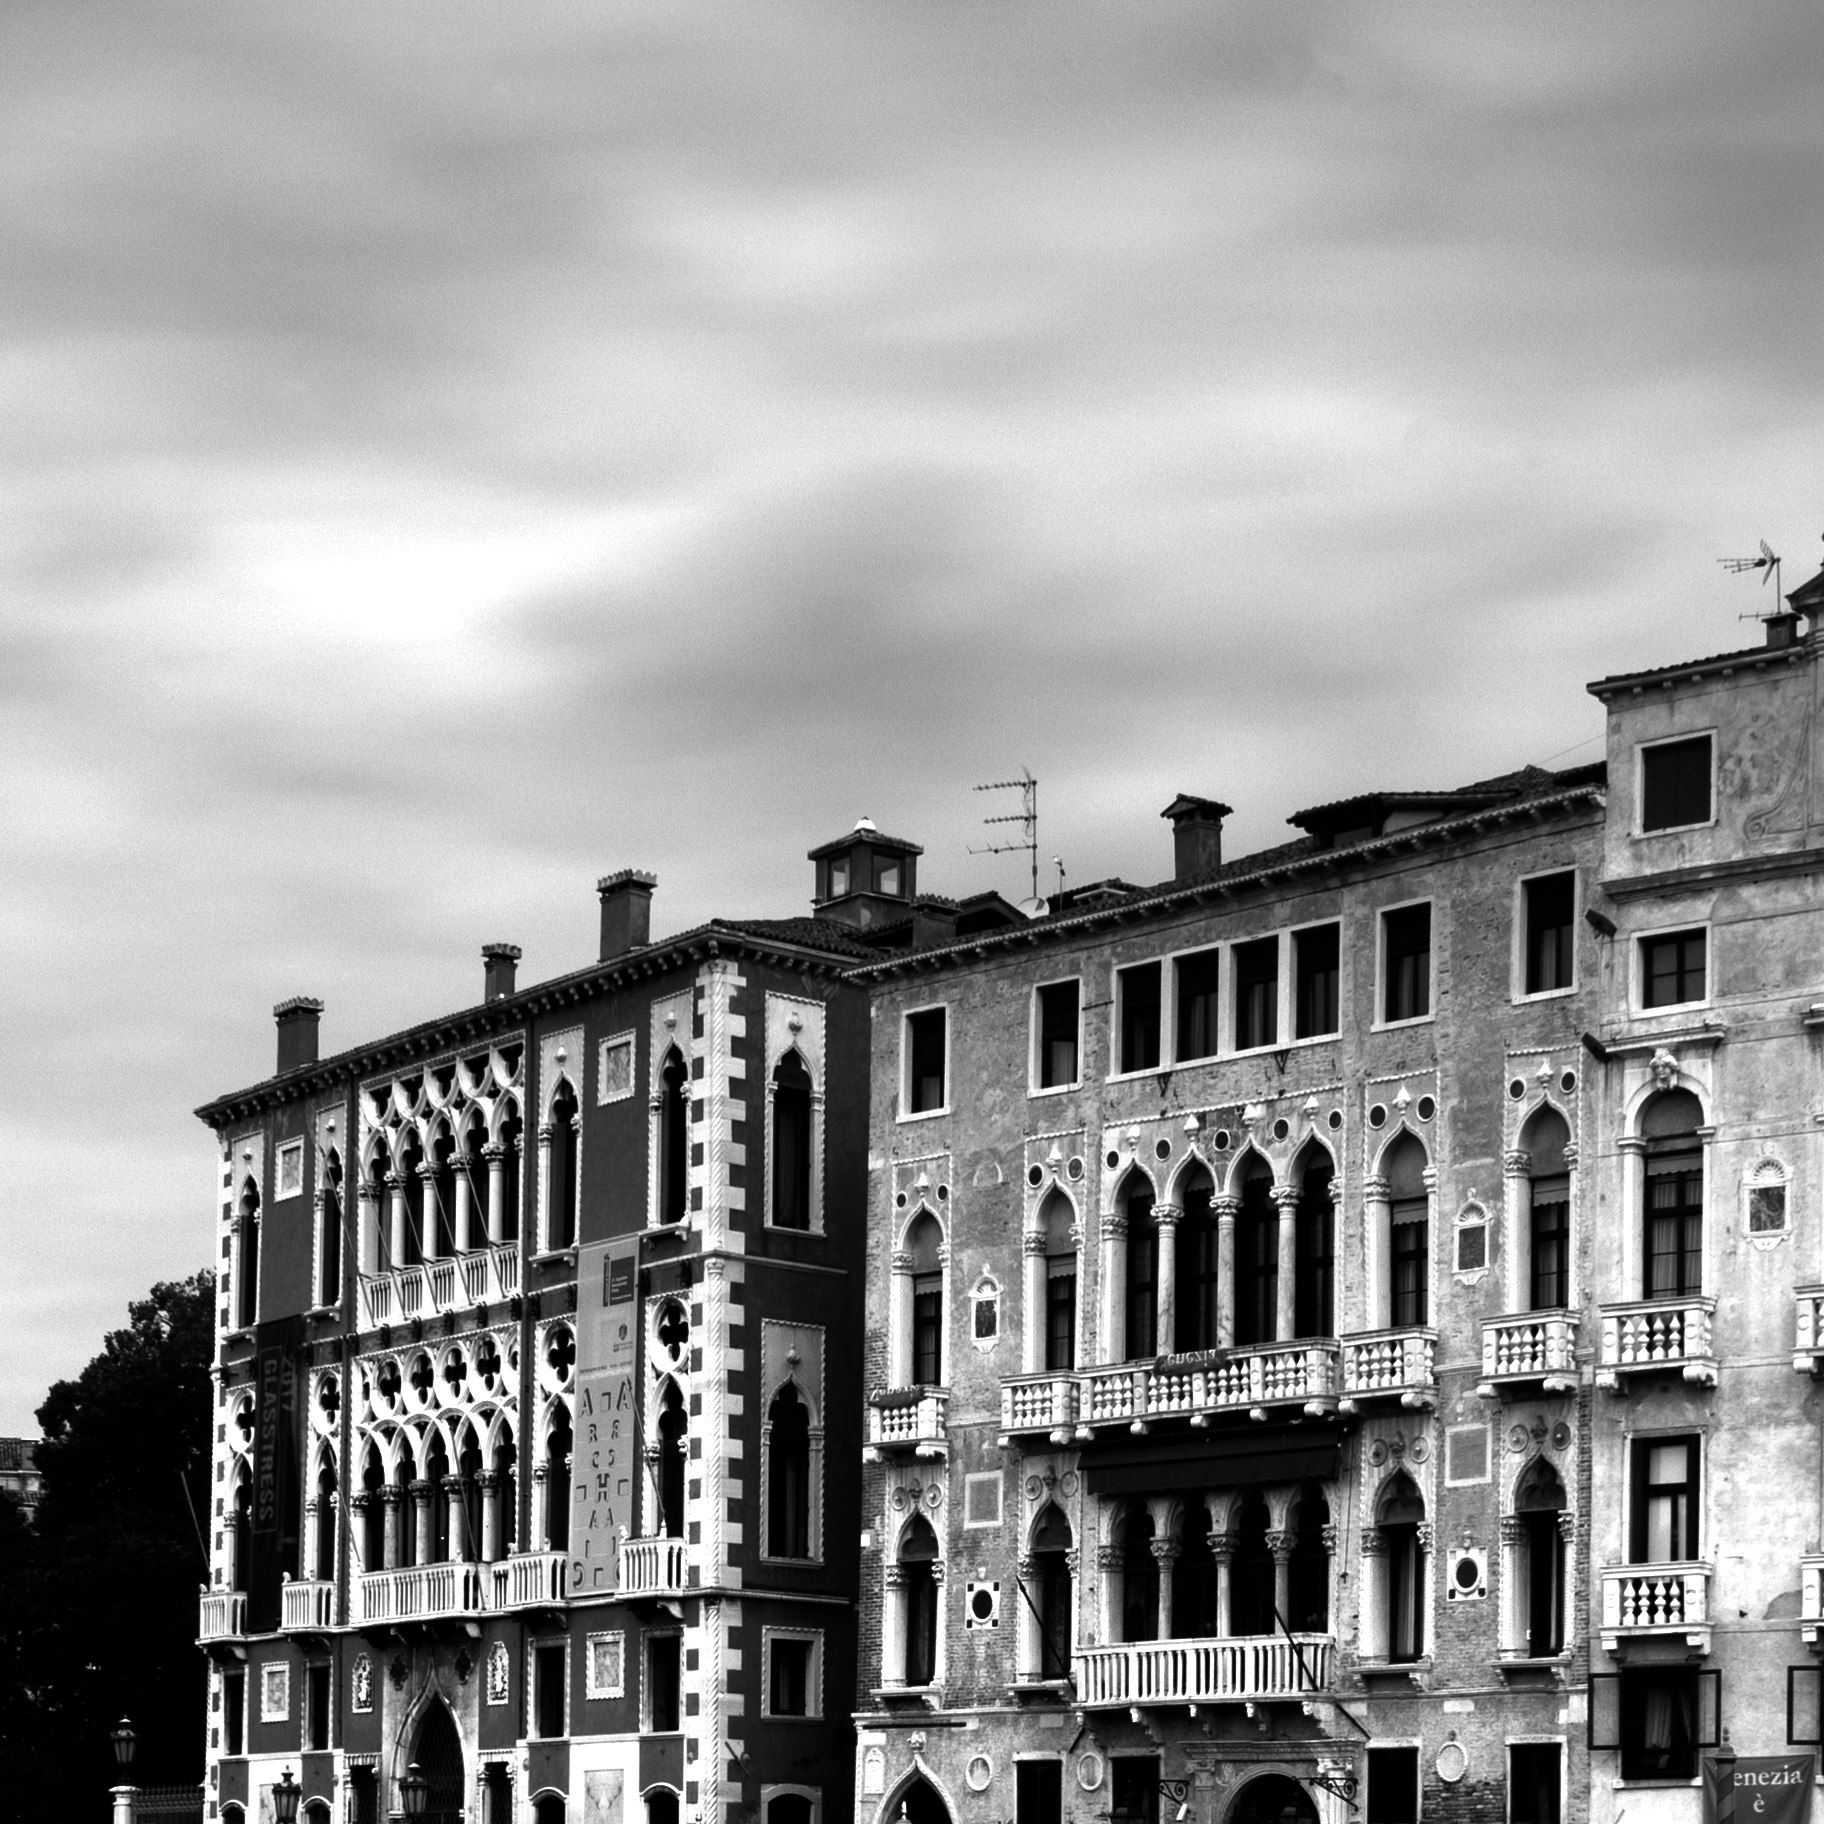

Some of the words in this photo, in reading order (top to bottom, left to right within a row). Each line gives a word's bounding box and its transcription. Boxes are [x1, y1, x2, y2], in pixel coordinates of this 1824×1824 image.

[259, 1358, 278, 1521] GLASSTRESS
[1733, 1764, 1803, 1787] enezia
[1753, 1793, 1765, 1814] è
